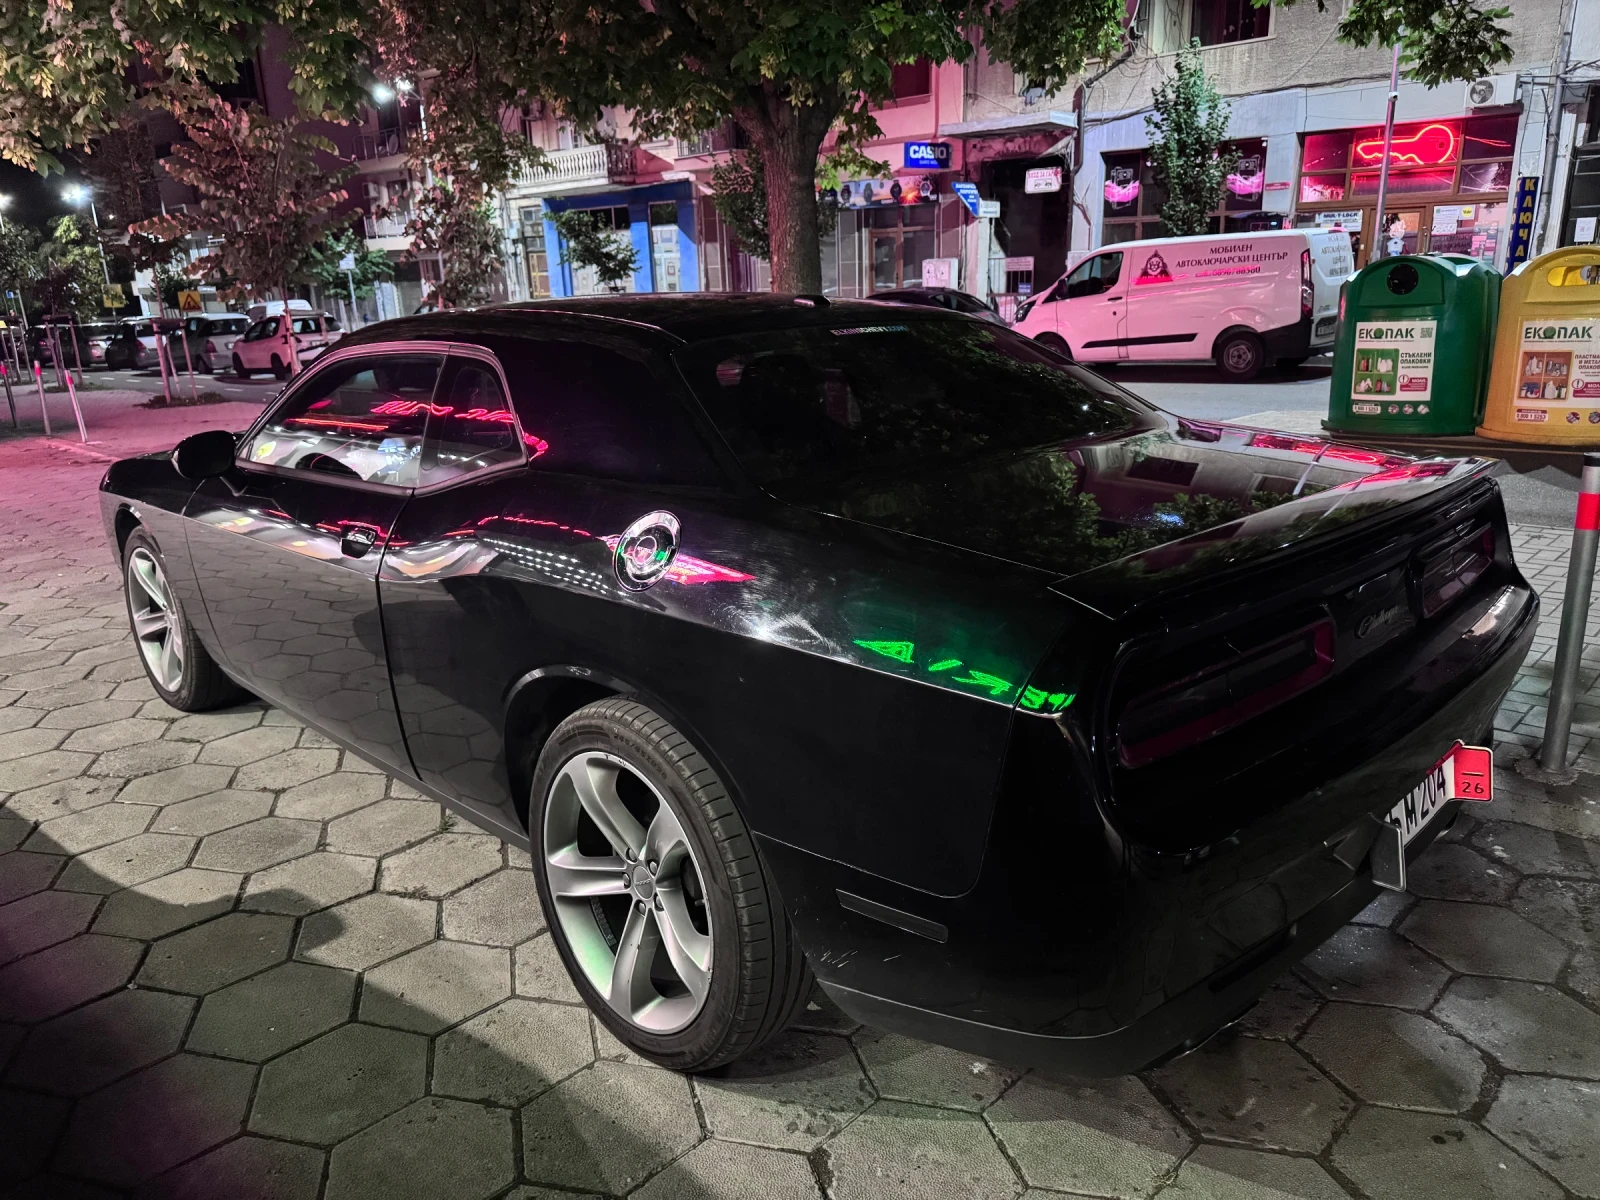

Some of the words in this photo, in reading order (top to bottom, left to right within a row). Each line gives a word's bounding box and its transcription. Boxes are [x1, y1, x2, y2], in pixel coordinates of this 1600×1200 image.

[909, 145, 947, 159] CASIO
[1210, 244, 1253, 254] МОБИЛЕН
[1175, 254, 1250, 268] АВТОКЛЮЧАРСКИ
[1252, 252, 1288, 263] ЦЕНТЪР
[1359, 328, 1414, 339] ЕКОПАК
[1524, 326, 1593, 339] ЕКОПАК
[1461, 781, 1485, 794] 26
